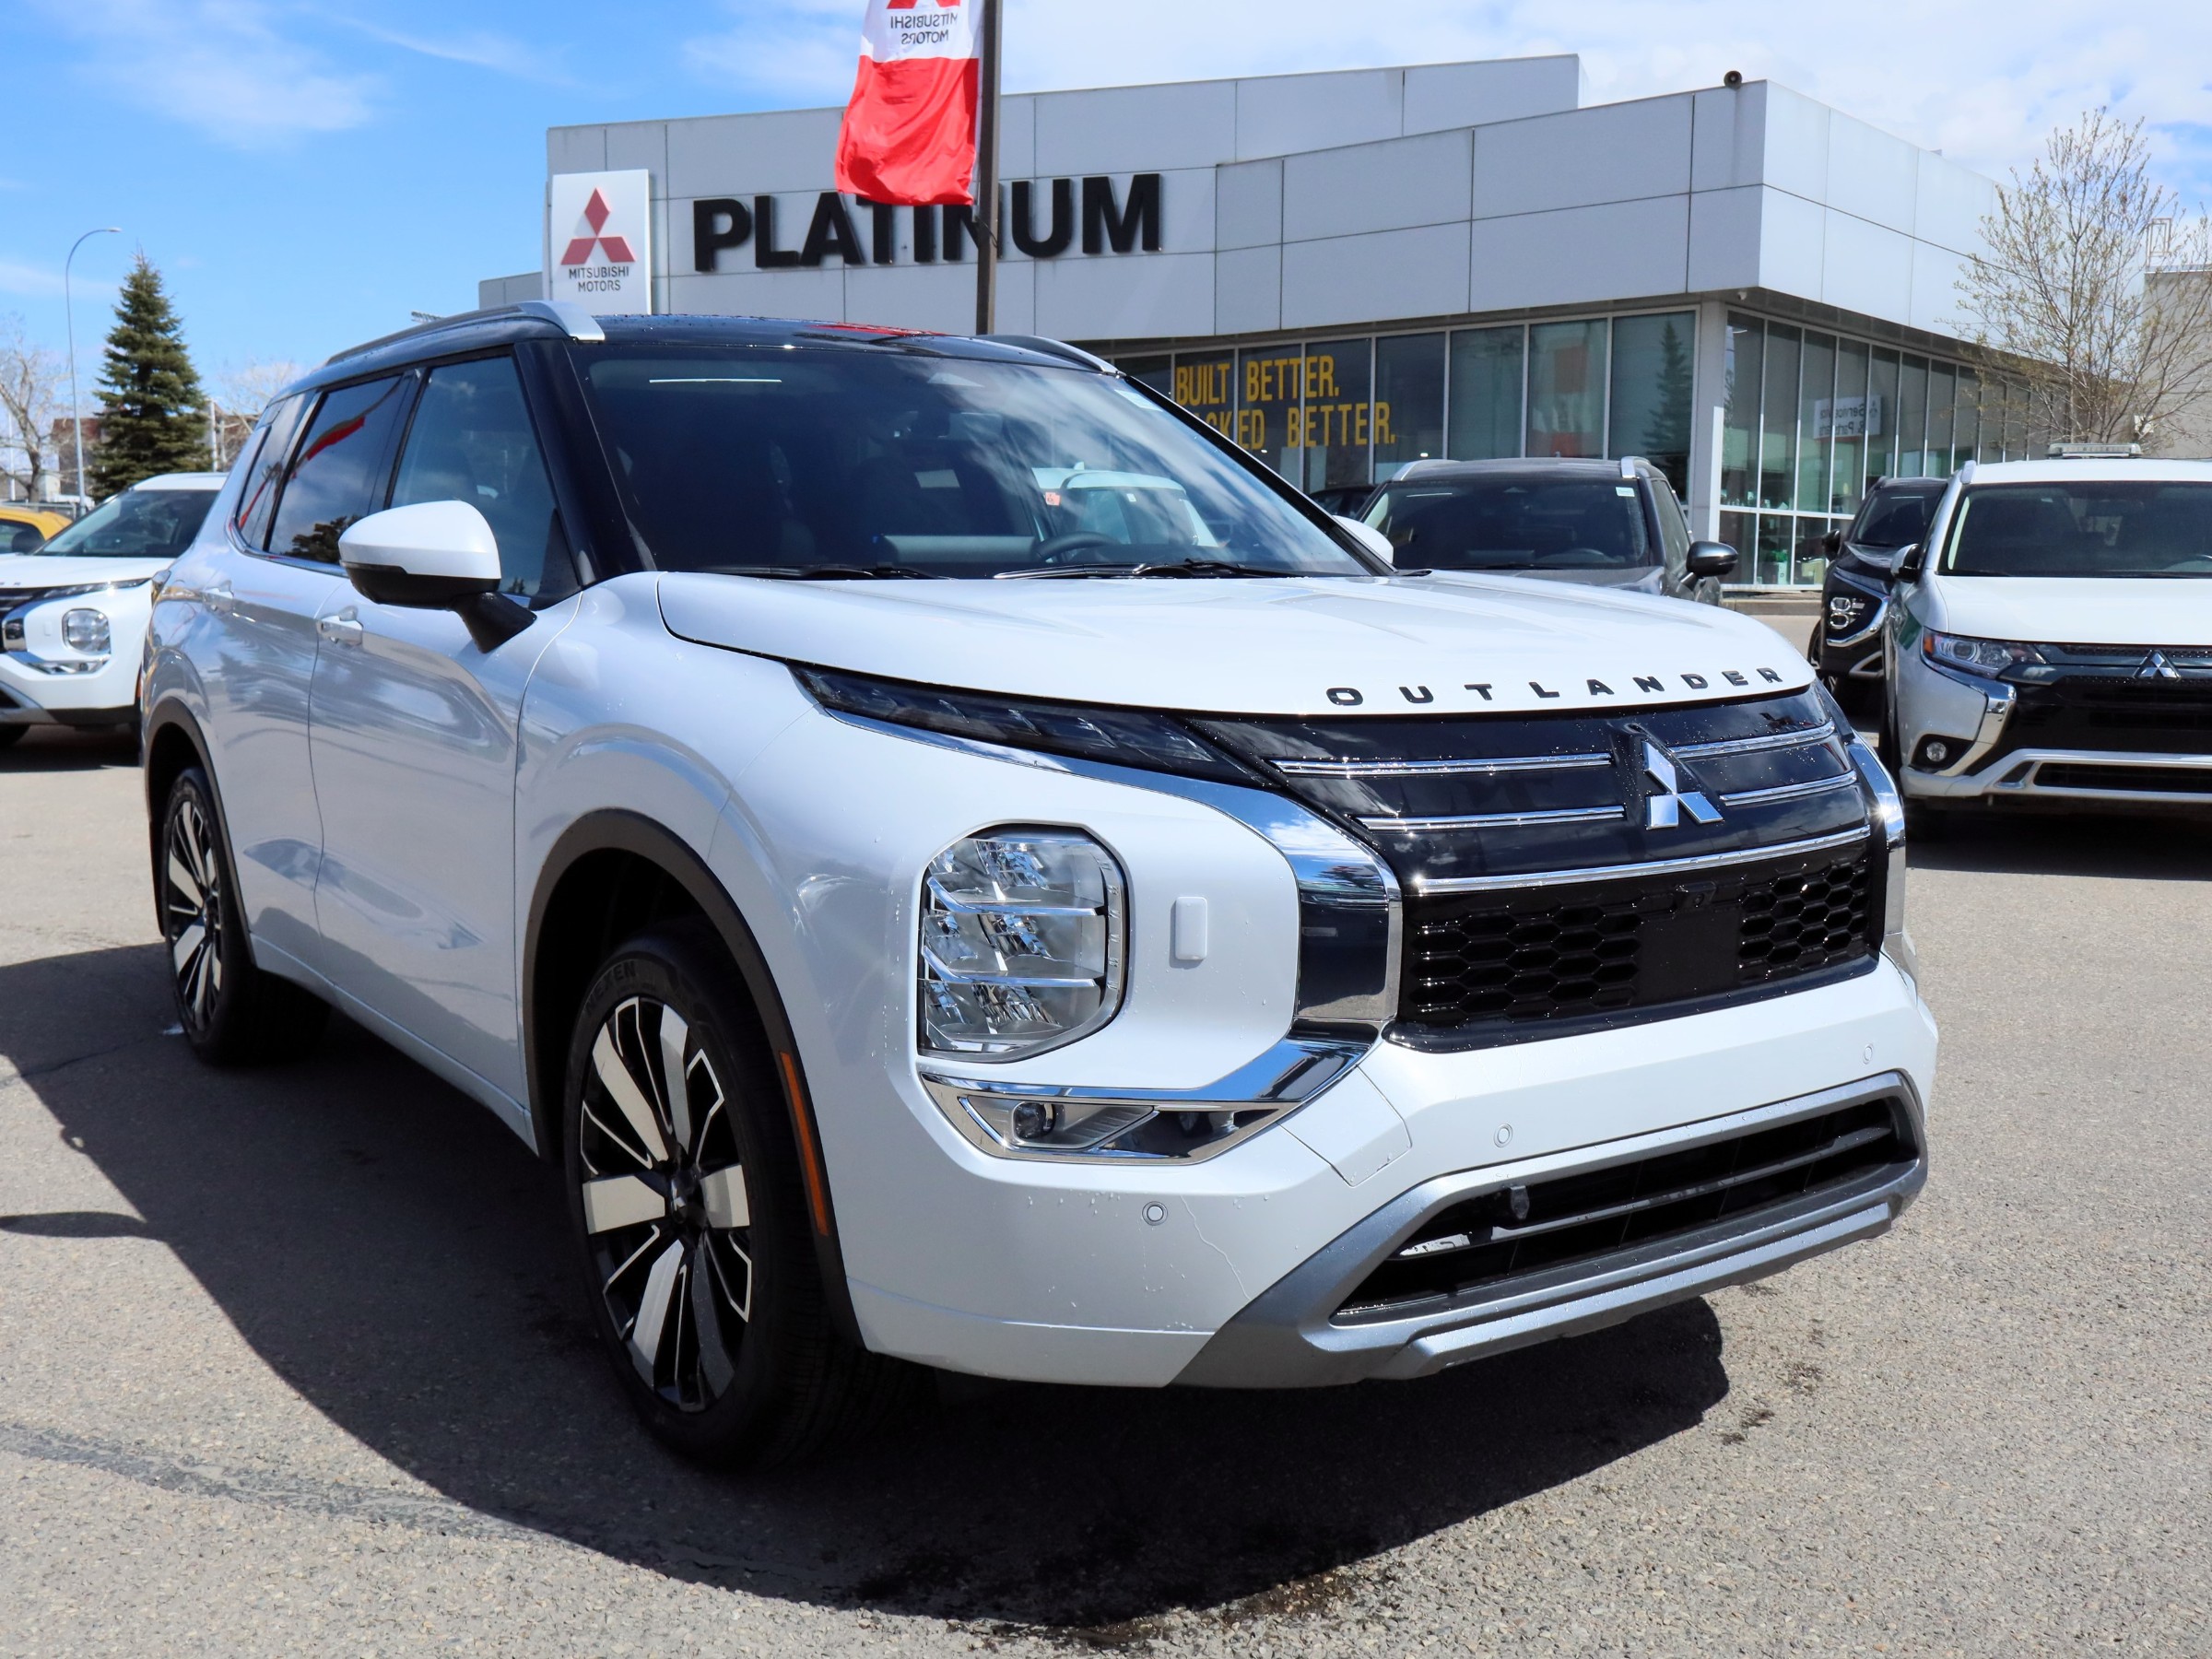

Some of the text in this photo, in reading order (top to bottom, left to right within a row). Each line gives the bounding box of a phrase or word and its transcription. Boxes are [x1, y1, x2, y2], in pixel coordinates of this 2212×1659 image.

[569, 265, 629, 279] MITSUBISHI
[578, 279, 621, 292] MOTORS
[1175, 355, 1340, 406] BUILT BETTER.
[1288, 402, 1396, 448] BETTER.
[1325, 666, 1784, 707] OUTLANDER
